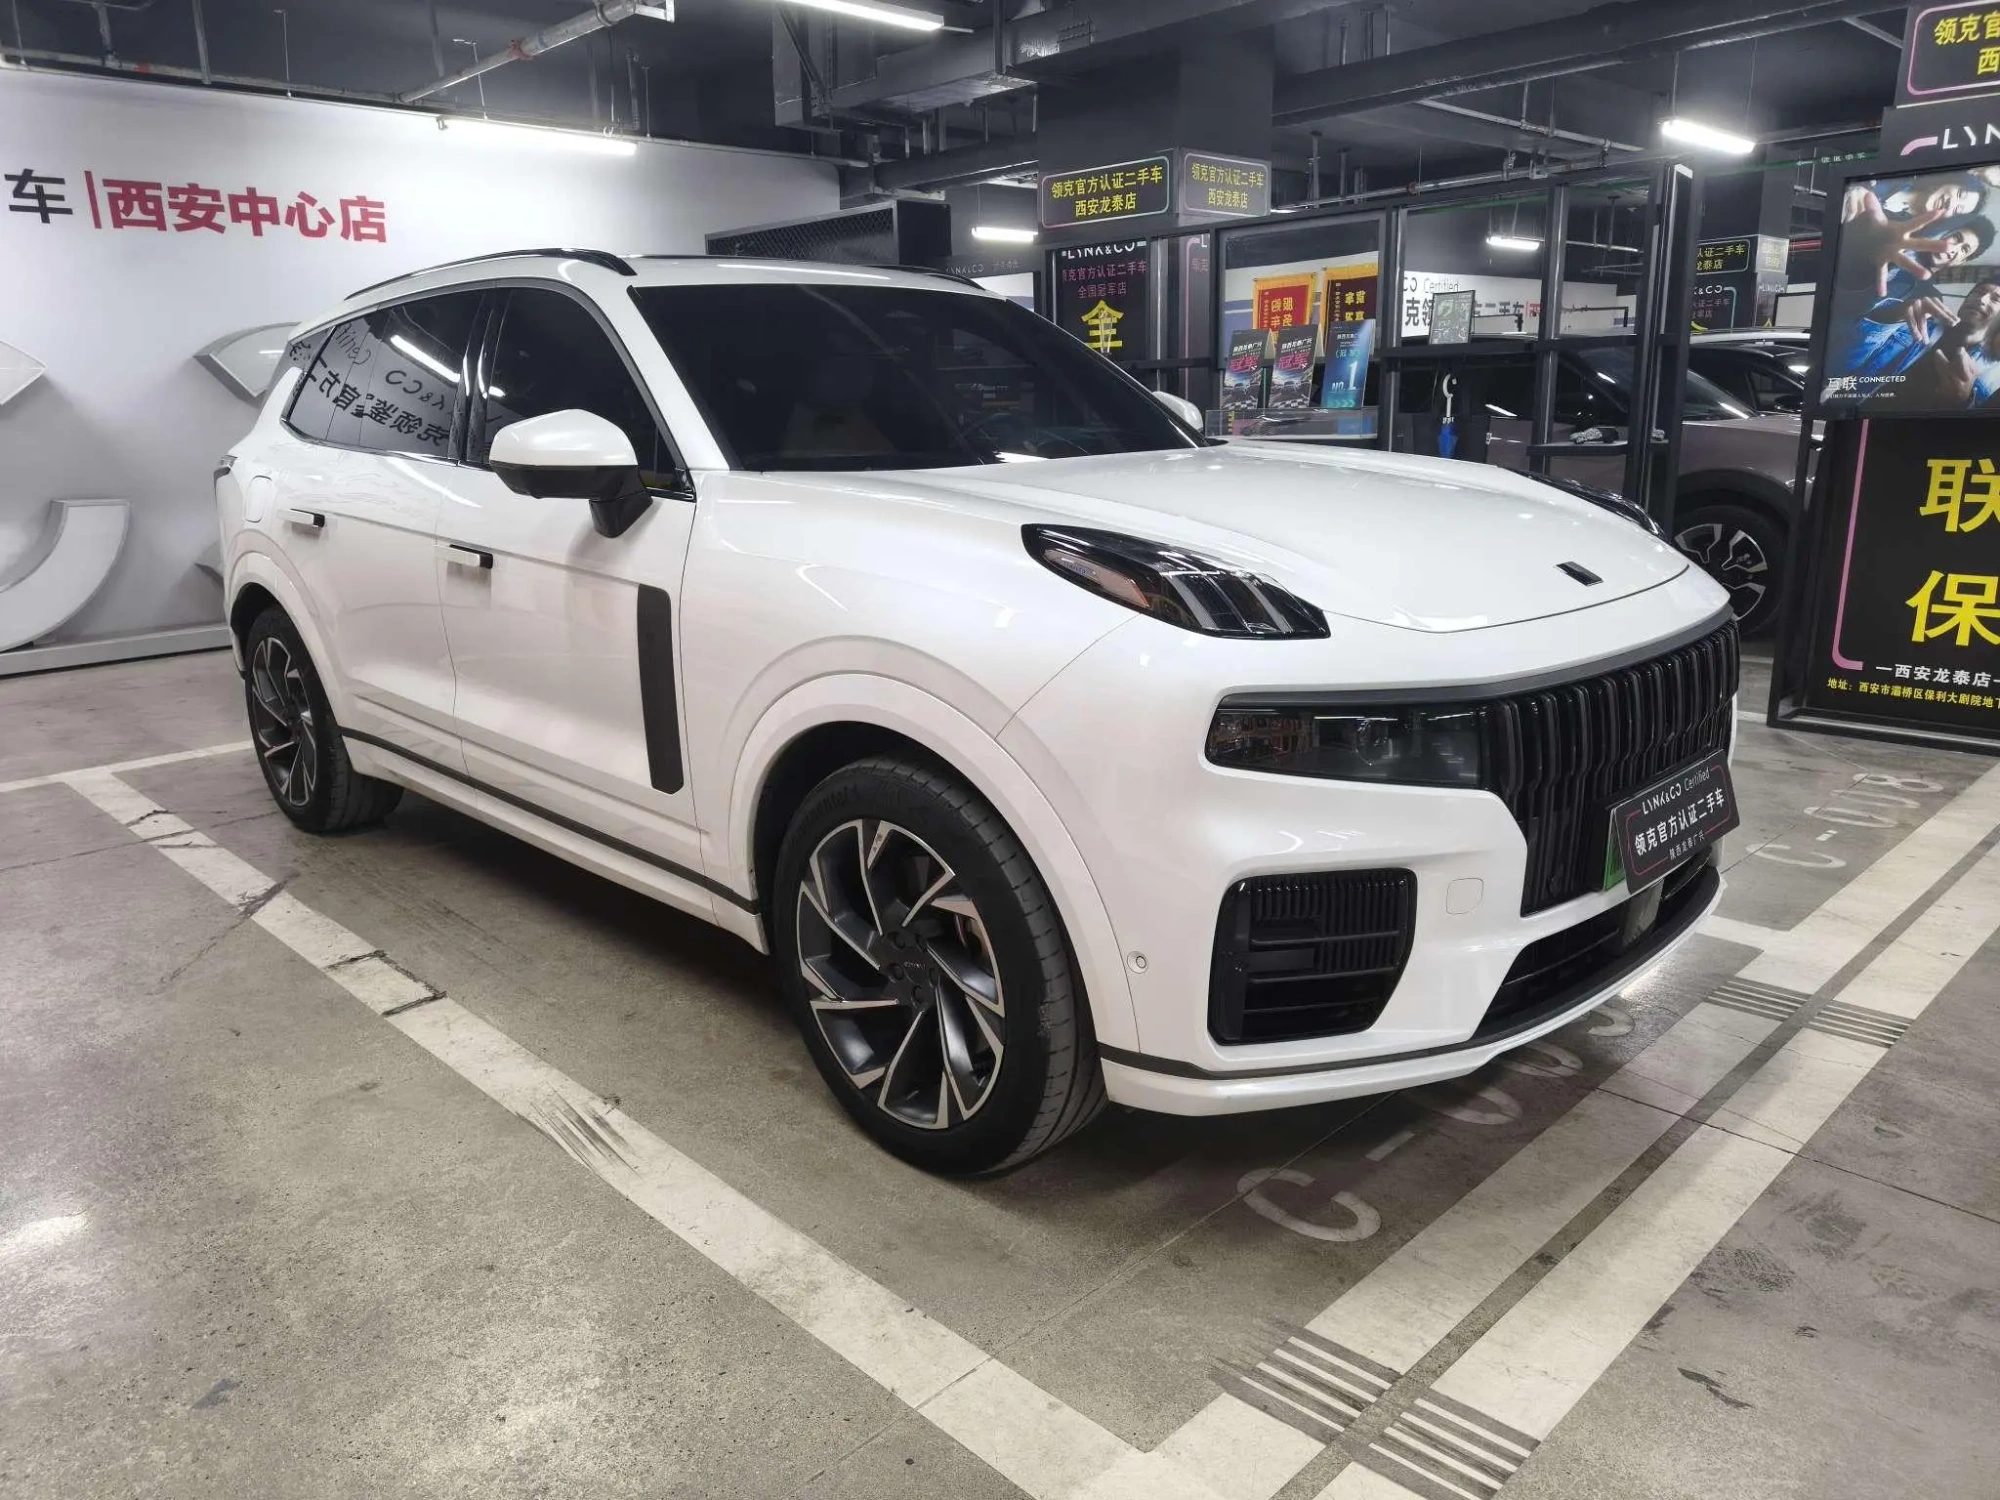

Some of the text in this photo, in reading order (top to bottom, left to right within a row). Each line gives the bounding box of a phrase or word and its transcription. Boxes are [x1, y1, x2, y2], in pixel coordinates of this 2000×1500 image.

[1052, 165, 1164, 198] 领克官方认证二手车
[1191, 162, 1264, 188] 领克官方认证二手车
[103, 178, 387, 243] 西安中心店
[1075, 192, 1137, 218] 西安龙泰店
[1208, 188, 1248, 209] 西安龙泰店
[1858, 375, 1907, 384] CONNECTED
[1906, 570, 2000, 647] 保
[1684, 767, 1710, 792] Certified
[1635, 788, 1725, 857] 领克官方认证二手车
